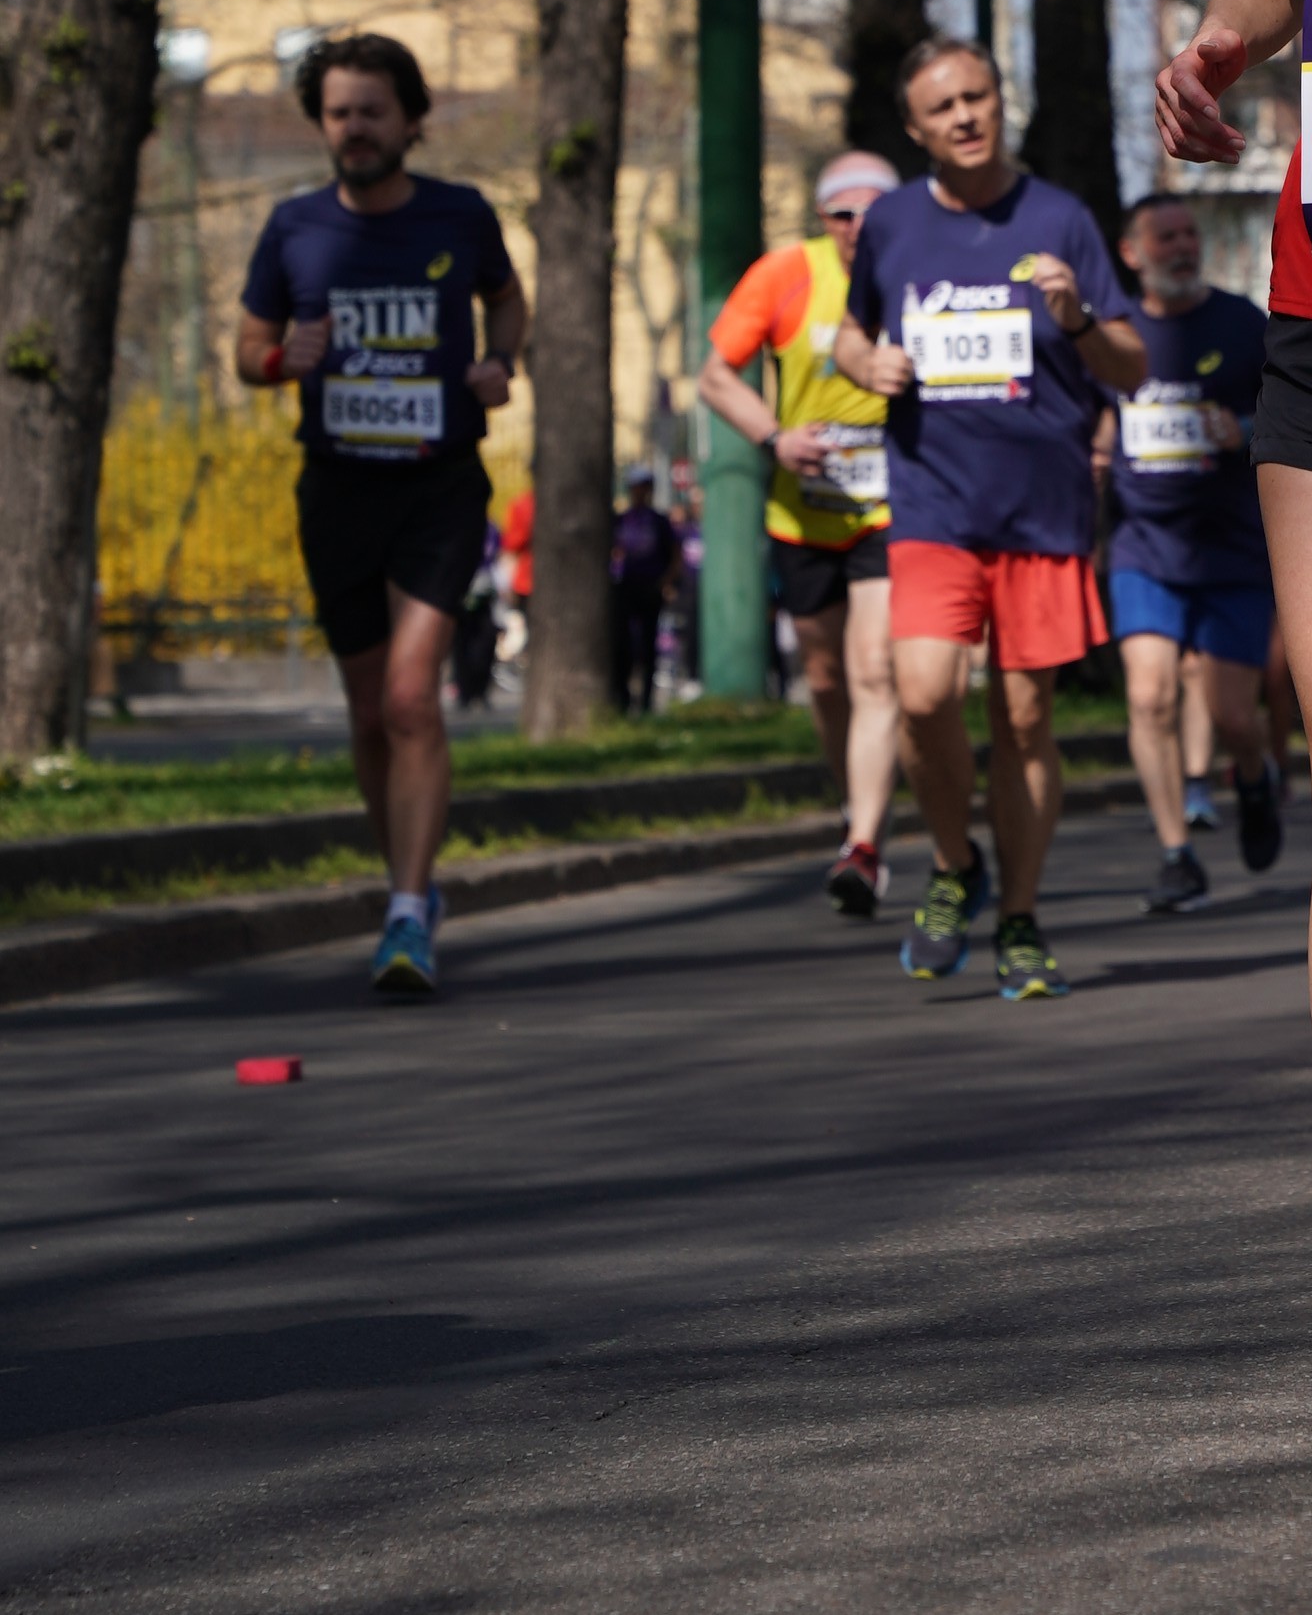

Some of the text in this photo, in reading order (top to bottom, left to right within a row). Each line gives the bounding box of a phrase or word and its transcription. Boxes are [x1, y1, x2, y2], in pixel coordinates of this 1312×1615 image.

[330, 302, 438, 350] RUN
[944, 334, 992, 362] 103
[346, 395, 418, 425] 6054
